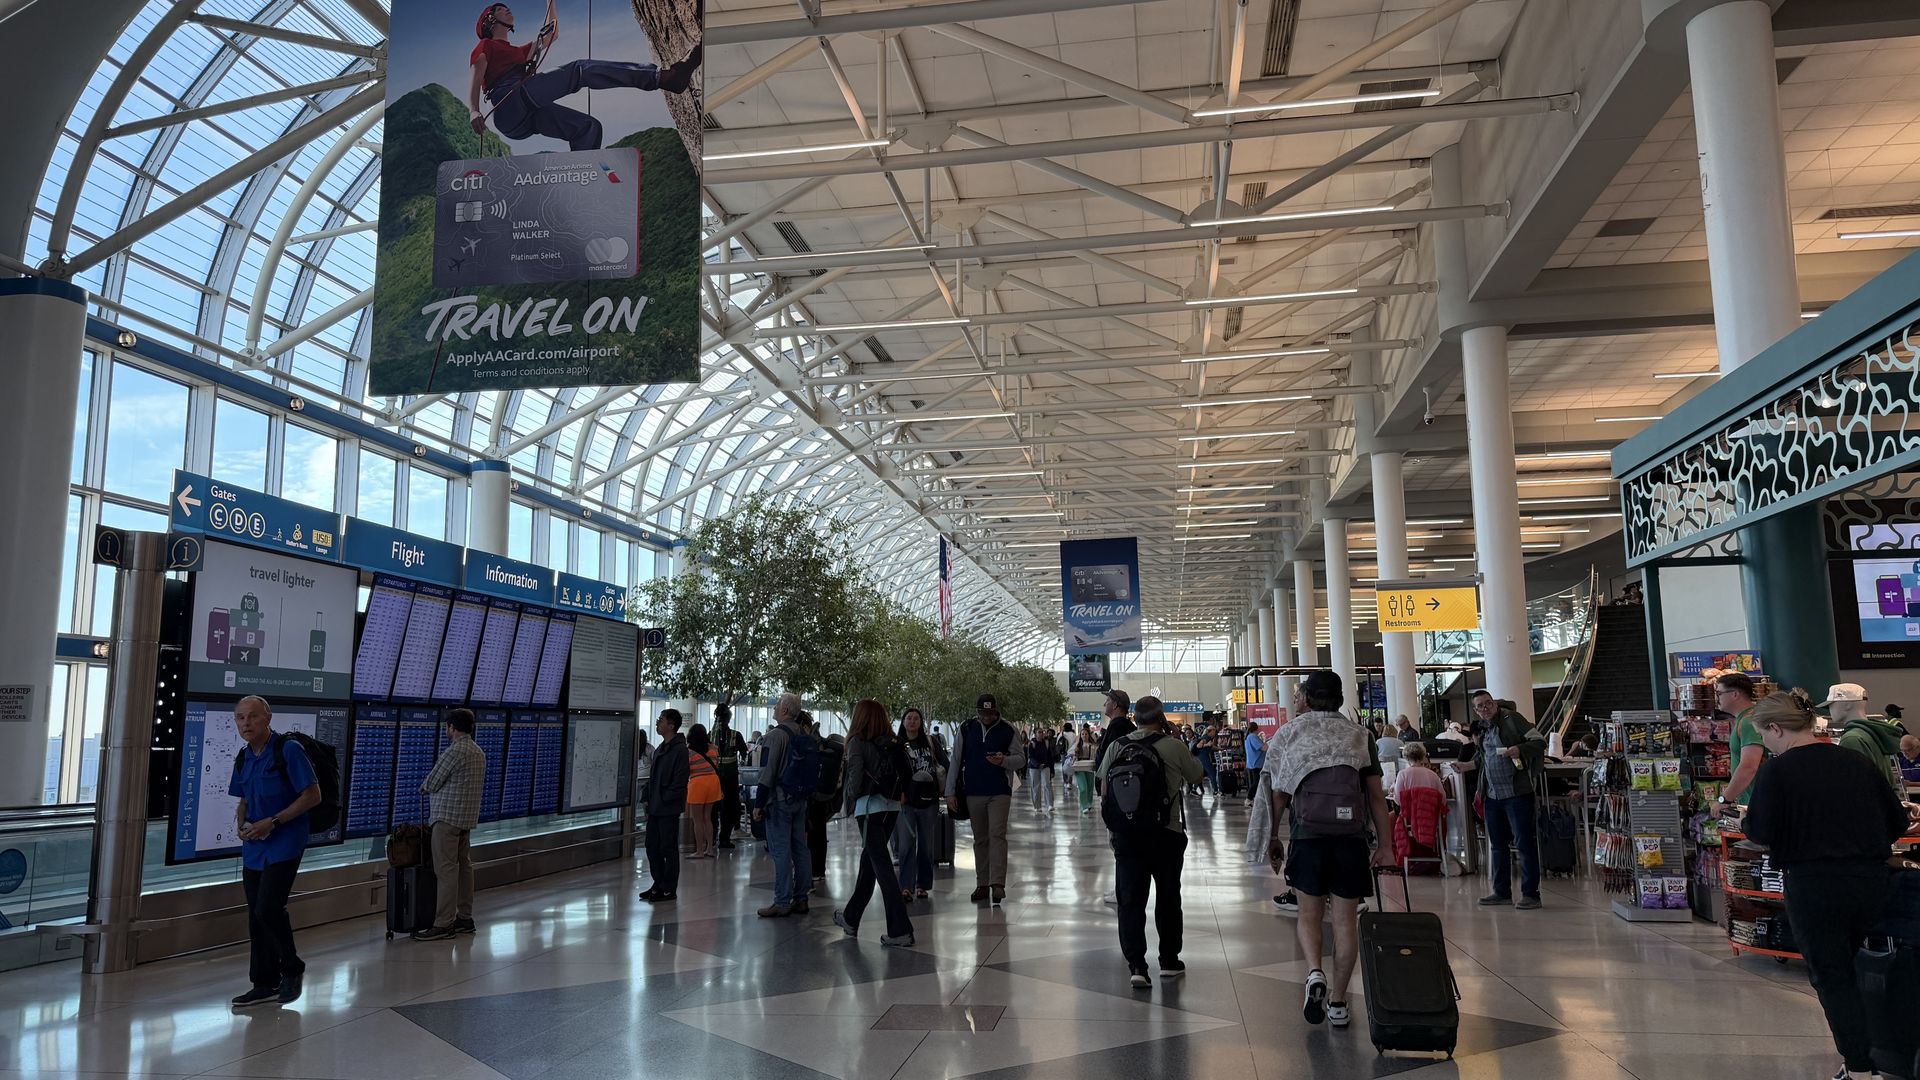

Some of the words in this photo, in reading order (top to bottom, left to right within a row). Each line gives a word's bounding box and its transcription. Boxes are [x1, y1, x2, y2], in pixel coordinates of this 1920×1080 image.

[451, 170, 487, 192] citi
[514, 169, 598, 187] AAdvantage
[512, 220, 540, 230] LINDA
[512, 230, 550, 240] WALKER
[510, 253, 539, 261] Platinum
[540, 251, 561, 260] Select
[588, 263, 628, 272] mastercard
[421, 295, 573, 342] TRAVEL
[446, 345, 620, 366] ApplyAACard.com/airport
[472, 369, 499, 378] Terms
[501, 368, 517, 377] and
[518, 366, 566, 376] conditions
[210, 485, 237, 502] Gates
[391, 541, 425, 568] Flight
[249, 565, 280, 583] travel
[282, 567, 316, 589] lighter
[383, 578, 407, 588] DEPARTURES
[485, 564, 538, 591] Information
[422, 586, 444, 596] DEPARTURES
[1069, 603, 1114, 618] TRAVEL
[1115, 604, 1133, 617] ON
[319, 710, 346, 718] DIRECTORY
[1643, 885, 1659, 893] POP
